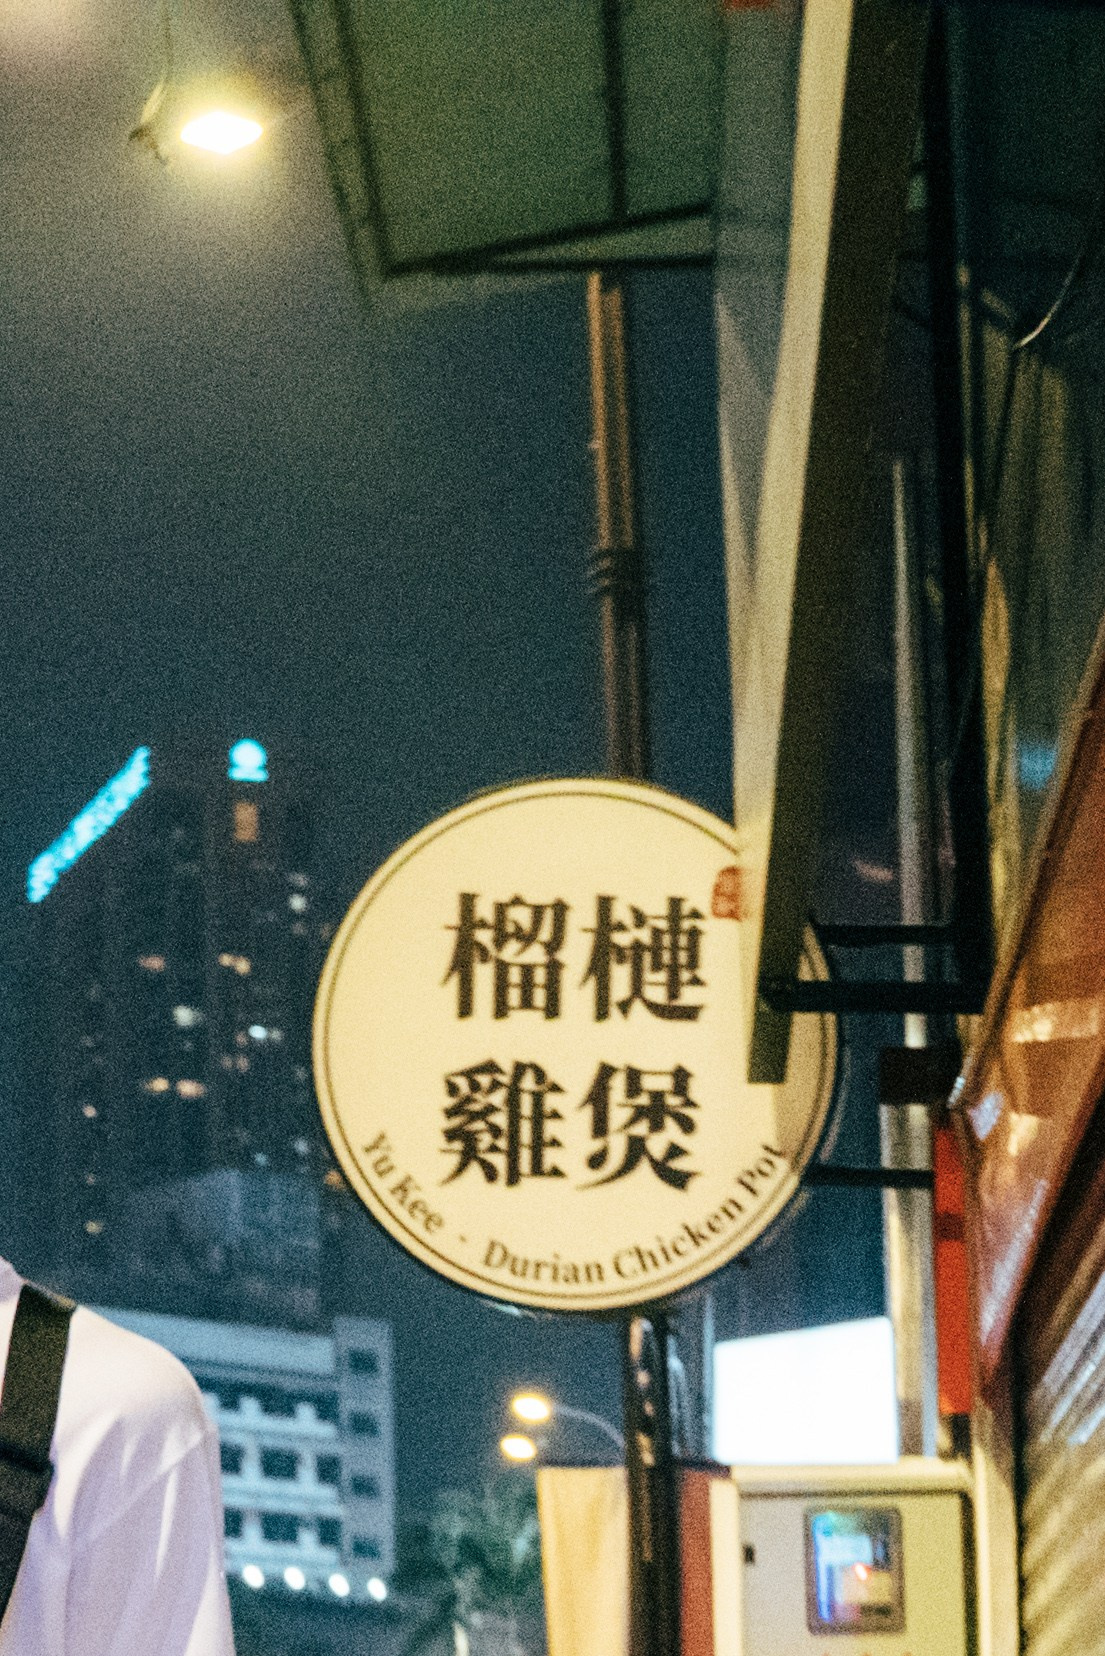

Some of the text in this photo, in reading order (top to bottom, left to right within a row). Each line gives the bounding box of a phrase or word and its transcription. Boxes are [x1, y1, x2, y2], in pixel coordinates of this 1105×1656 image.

[440, 892, 707, 1023] 榴槤
[440, 1059, 703, 1191] 雞煲
[362, 1130, 786, 1285] Yu Kee Durian Chicken Pot
